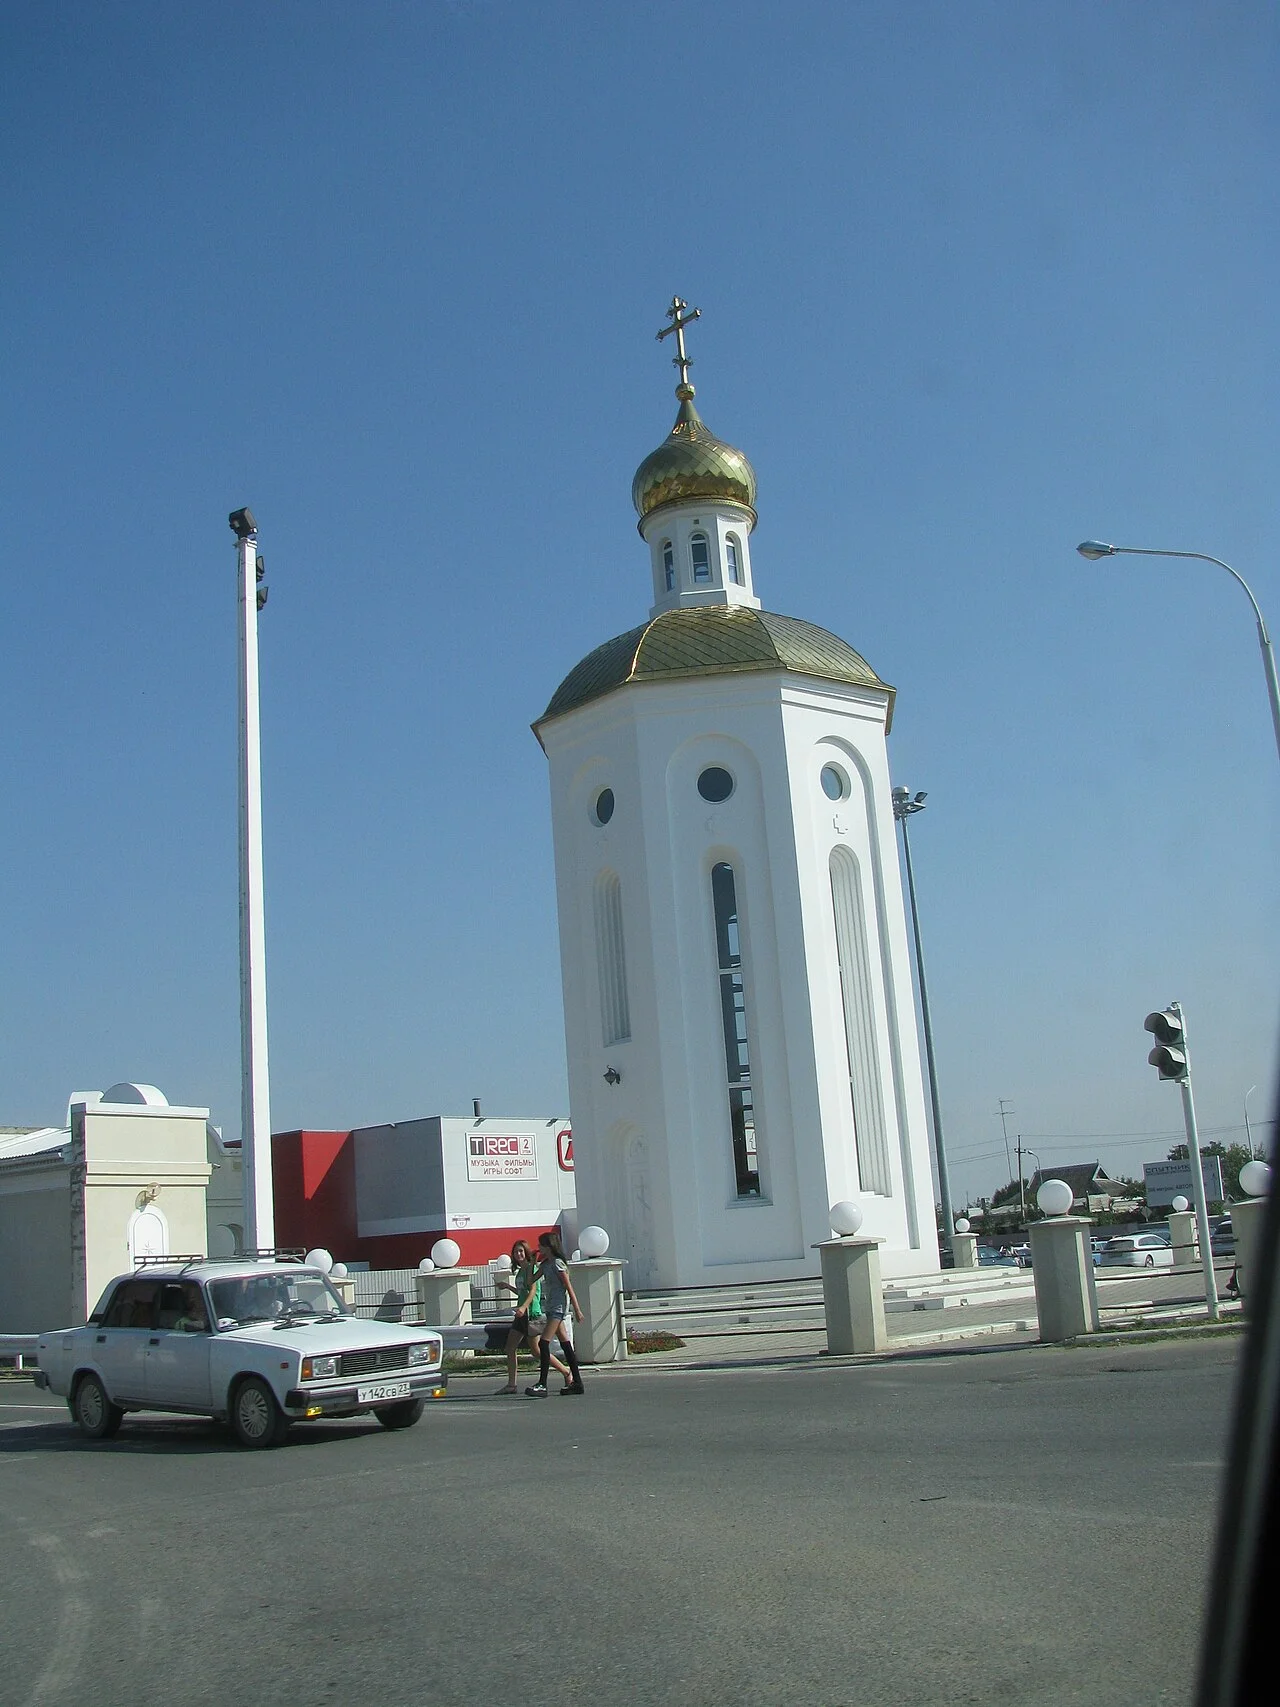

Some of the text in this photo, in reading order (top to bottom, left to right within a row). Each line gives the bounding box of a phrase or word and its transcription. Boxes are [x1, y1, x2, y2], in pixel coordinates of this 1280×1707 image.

[523, 1139, 529, 1149] 2
[471, 1159, 534, 1167] МУЗЫКА ФИЛЬМЫ
[504, 1167, 523, 1175] СОФТ
[399, 1384, 407, 1392] 23
